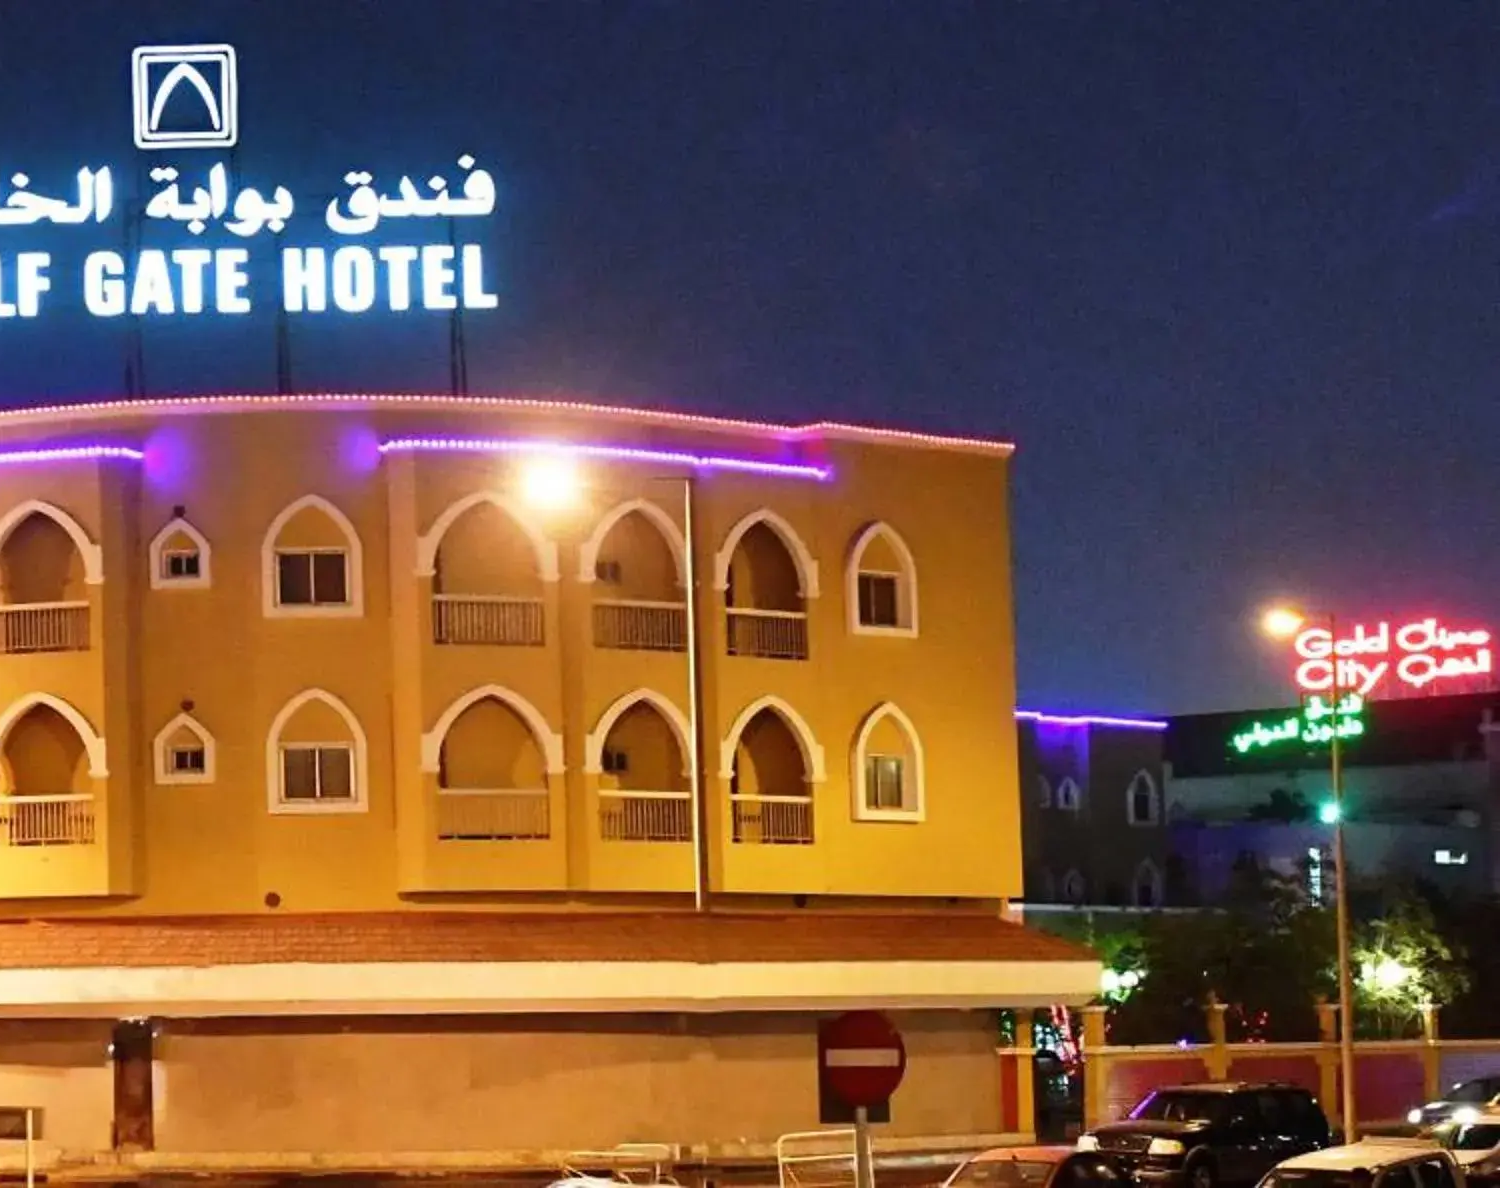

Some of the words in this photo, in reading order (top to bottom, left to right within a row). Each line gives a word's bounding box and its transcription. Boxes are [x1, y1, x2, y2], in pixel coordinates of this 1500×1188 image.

[147, 163, 294, 236] بوابة
[325, 154, 496, 234] فندق
[83, 249, 252, 317] GATE
[283, 245, 499, 313] HOTEL
[1295, 621, 1389, 660] Gold
[1295, 658, 1389, 695] City
